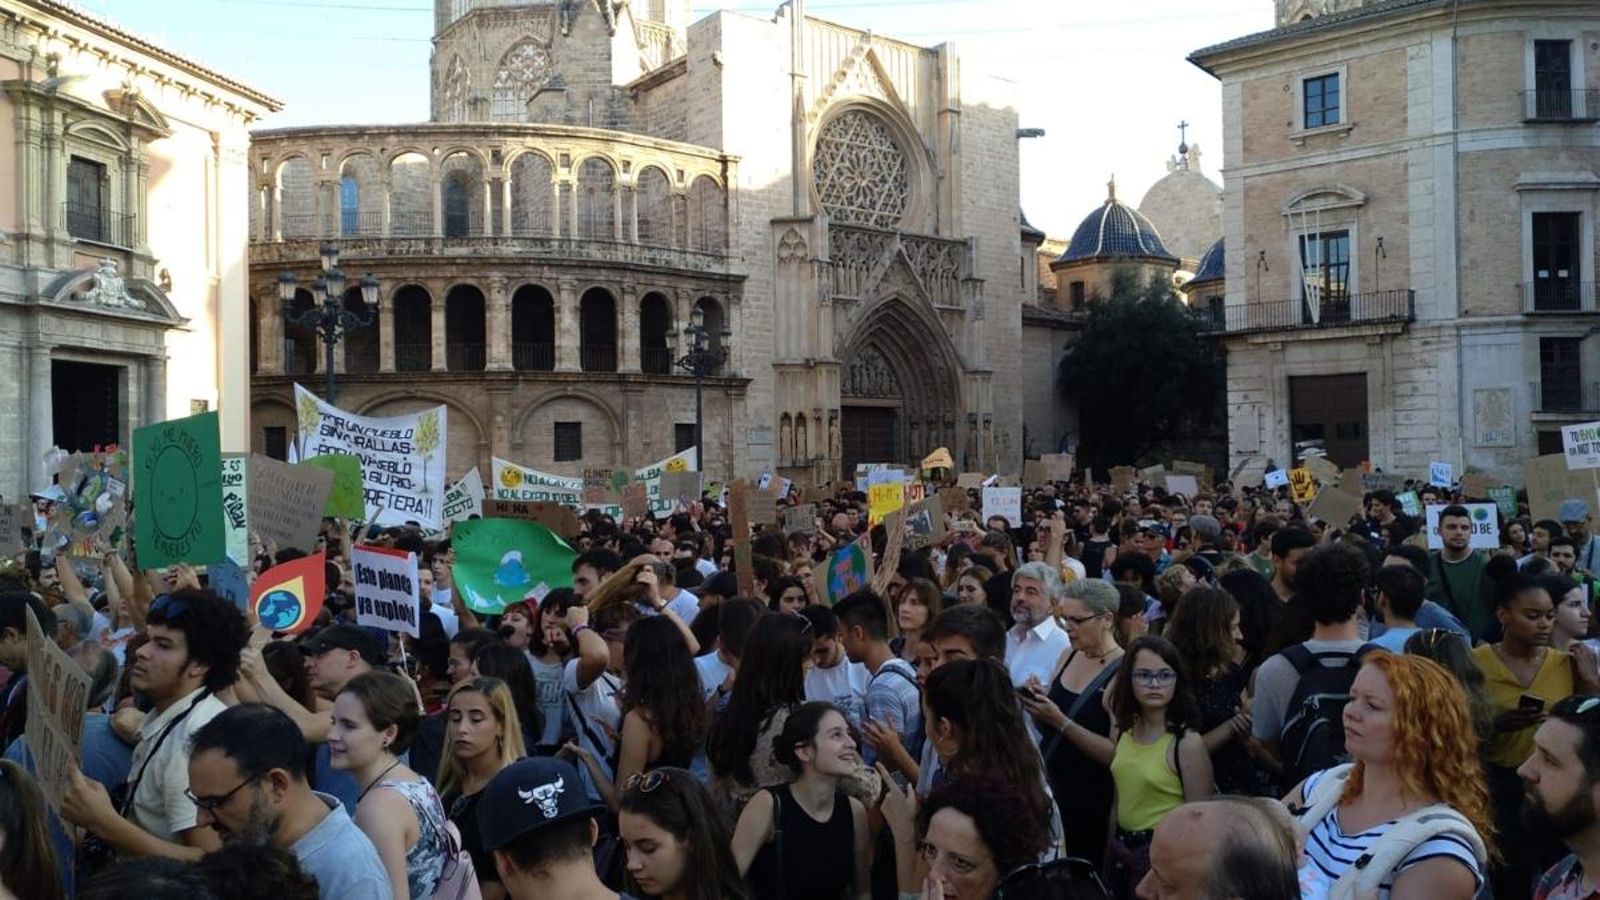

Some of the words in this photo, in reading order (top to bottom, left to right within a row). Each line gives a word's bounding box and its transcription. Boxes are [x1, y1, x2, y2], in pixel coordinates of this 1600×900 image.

[320, 424, 342, 440] SIN
[346, 420, 364, 434] UN
[369, 471, 389, 485] SU
[497, 489, 509, 499] NO
[1479, 523, 1492, 534] BE
[357, 596, 373, 615] ya
